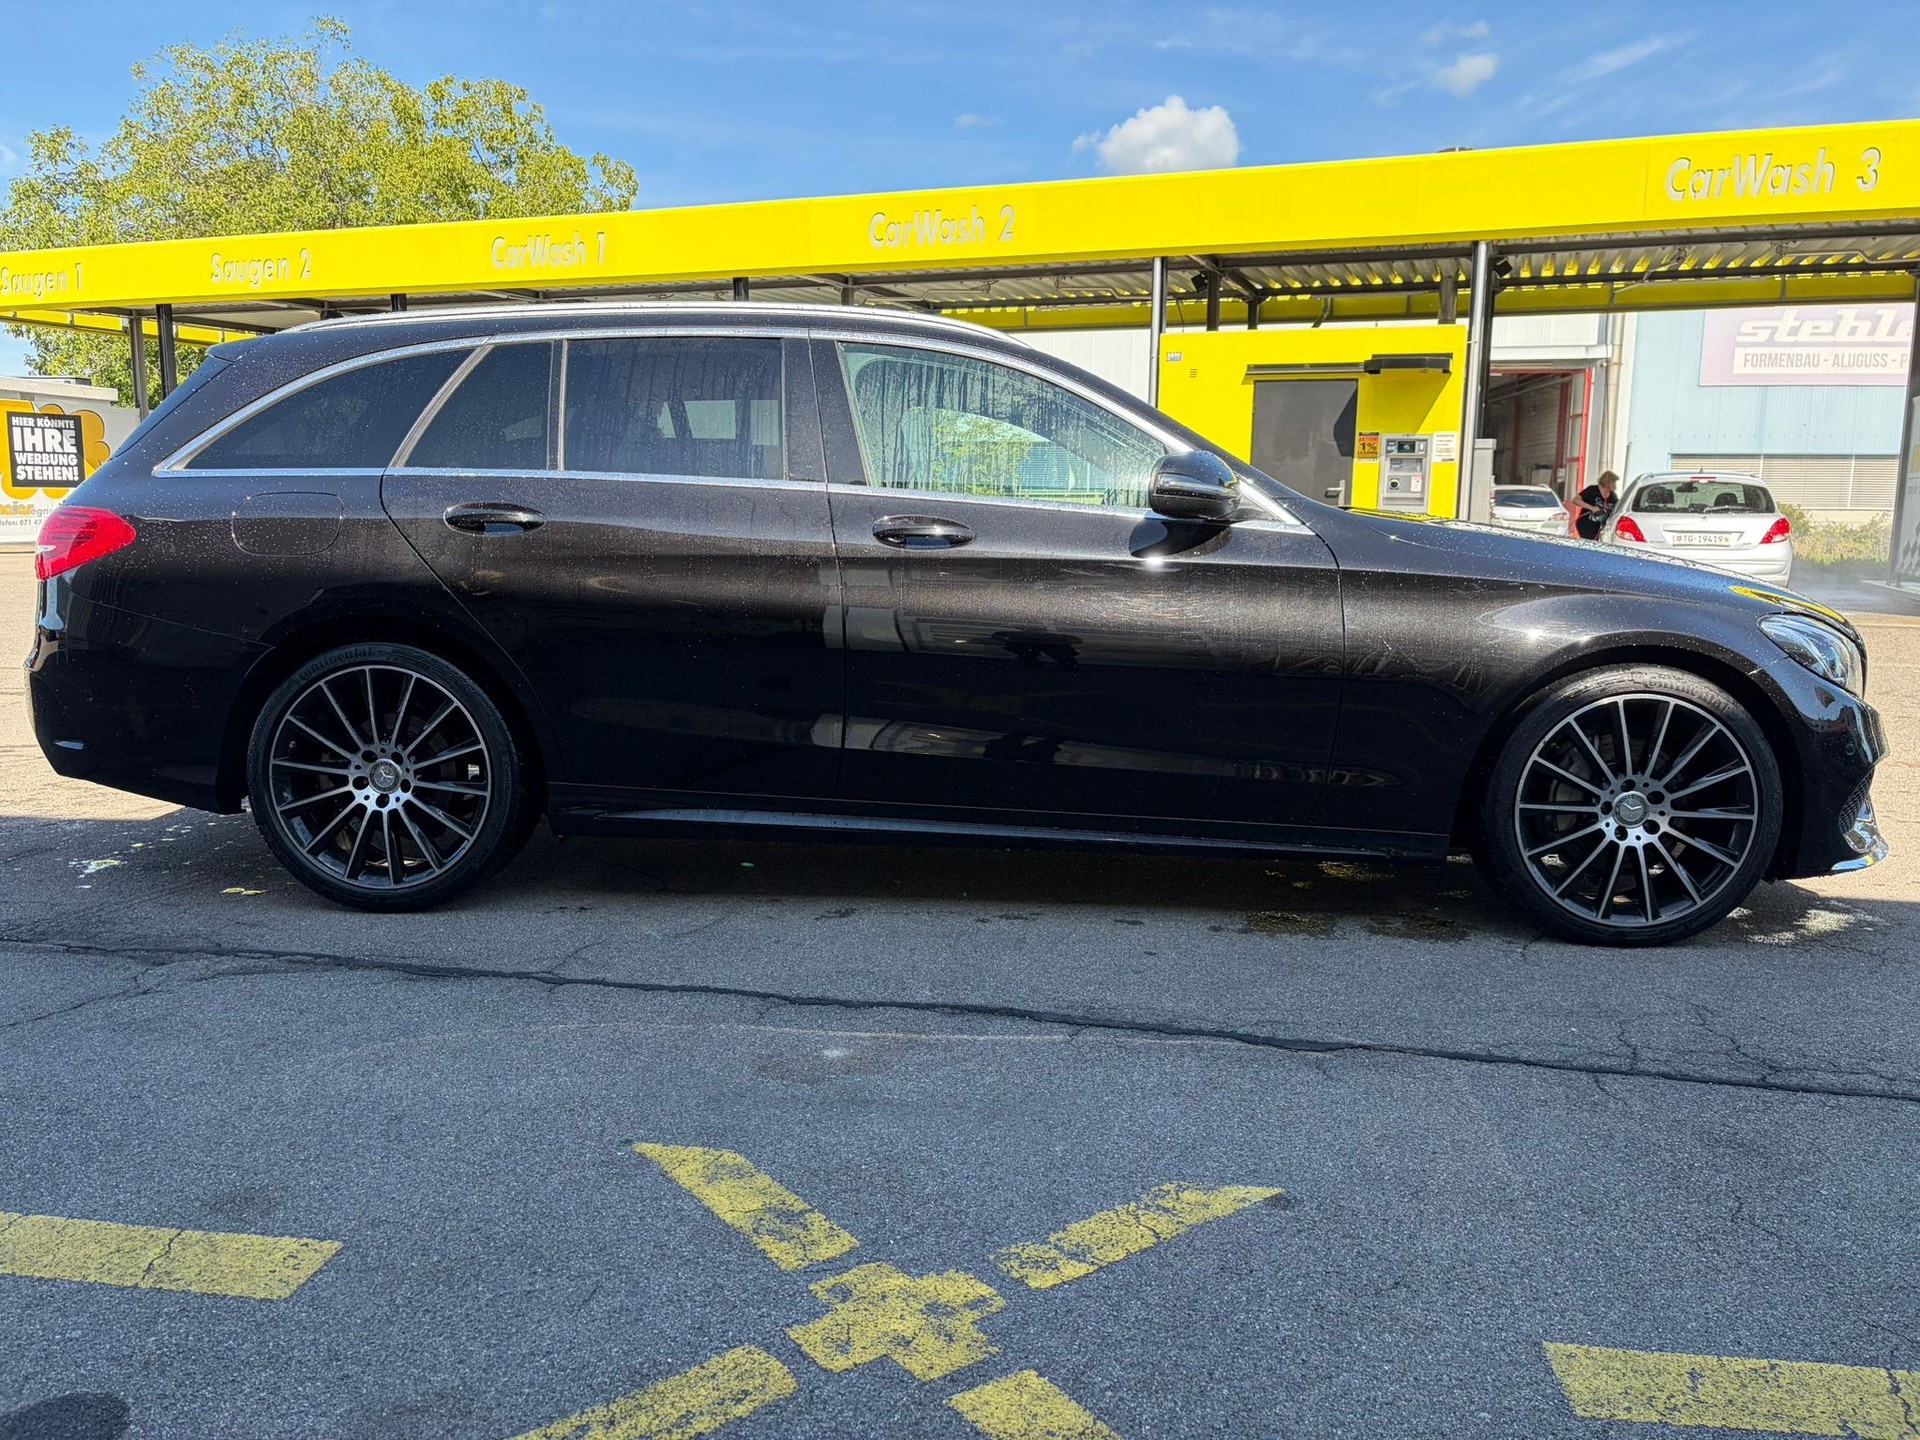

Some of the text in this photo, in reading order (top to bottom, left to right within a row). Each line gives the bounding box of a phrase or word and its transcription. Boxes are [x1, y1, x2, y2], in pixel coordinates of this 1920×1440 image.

[1665, 146, 1882, 202] CarWash 3
[868, 205, 1015, 249] CarWash 2
[490, 231, 607, 270] CarWash 1
[0, 262, 84, 300] Saugen 1
[211, 247, 312, 289] Saugen 2
[1743, 353, 1820, 369] FORMENBAU
[1831, 353, 1888, 368] ALUGUSS
[11, 416, 75, 429] HIER KÖNNTE
[12, 427, 77, 453] IHRE
[1359, 442, 1377, 451] 1%
[14, 452, 78, 466] WERBUNG
[16, 465, 79, 481] STEHEN!
